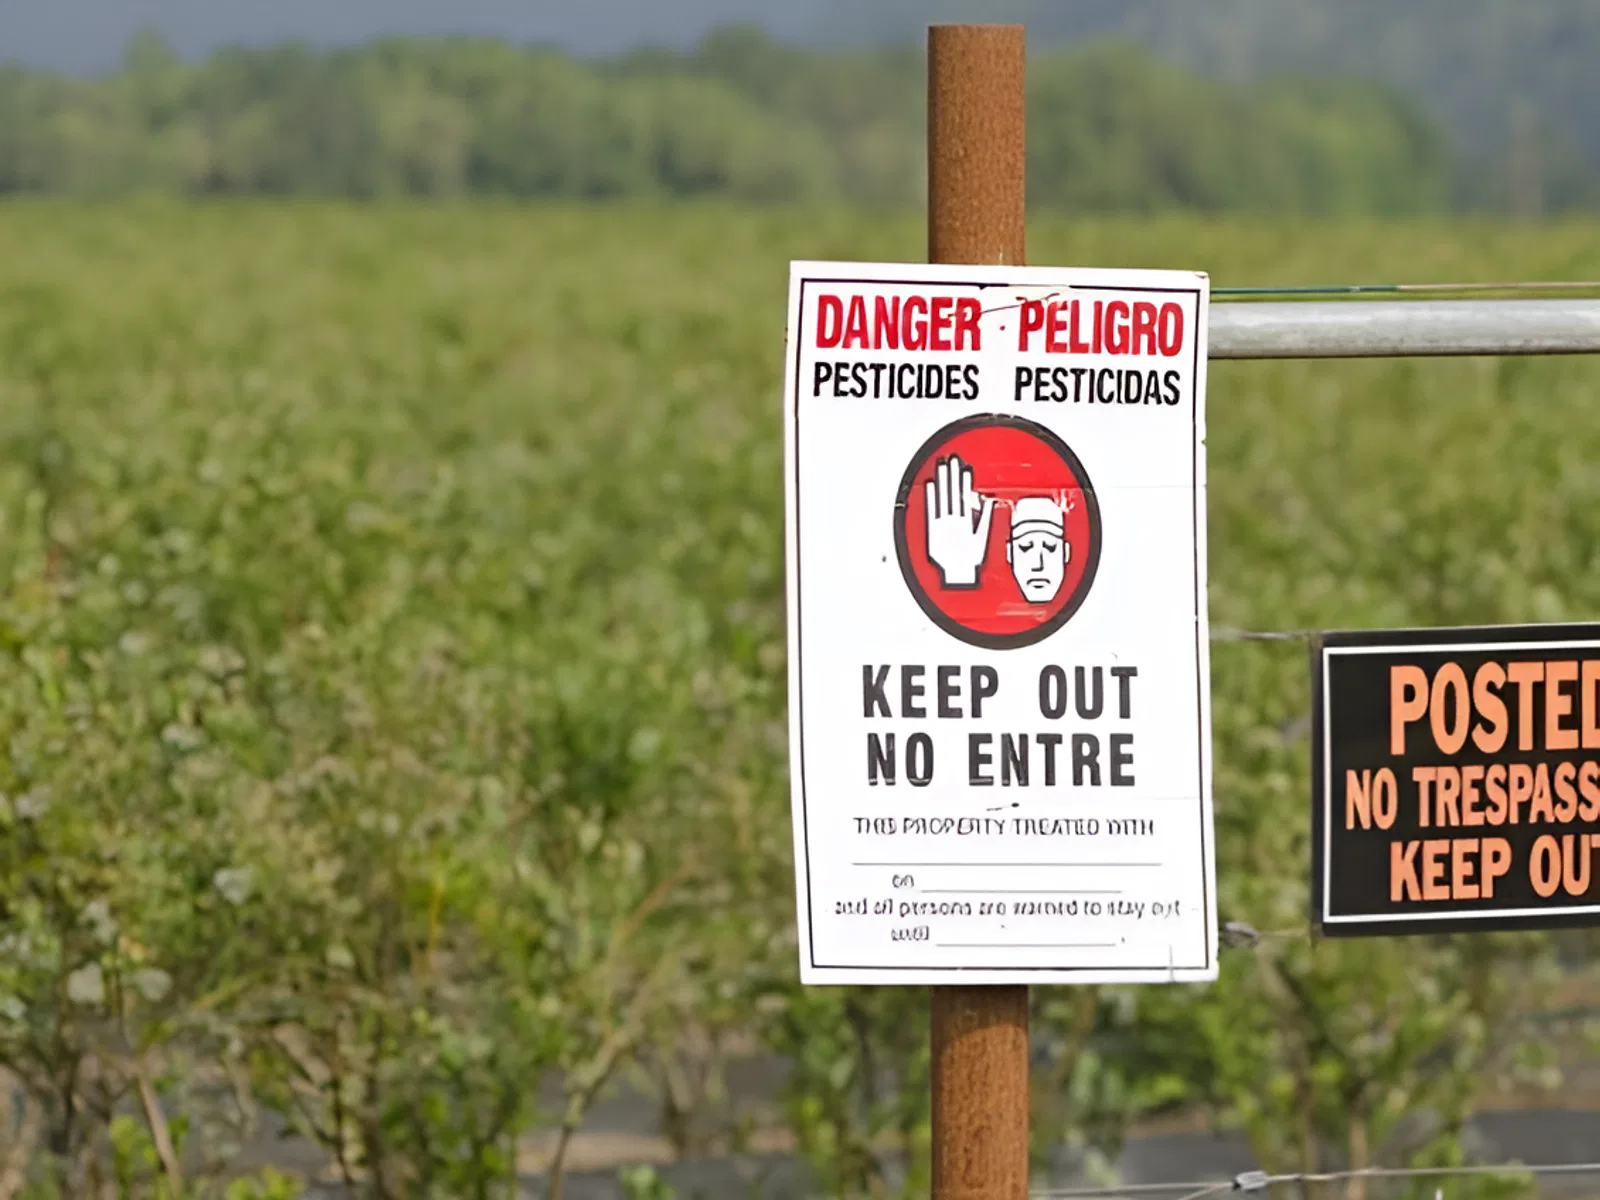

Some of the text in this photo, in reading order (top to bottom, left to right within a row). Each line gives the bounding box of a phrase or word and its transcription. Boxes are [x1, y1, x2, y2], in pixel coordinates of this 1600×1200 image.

[816, 294, 1184, 357] DANGER PELIGRO
[813, 361, 1181, 405] PESTICIDES PESTICIDAS
[862, 664, 1138, 719] KEEP OUT
[867, 732, 1136, 787] NO ENTRE
[1345, 767, 1398, 830] NO
[1390, 837, 1512, 902] KEEP
